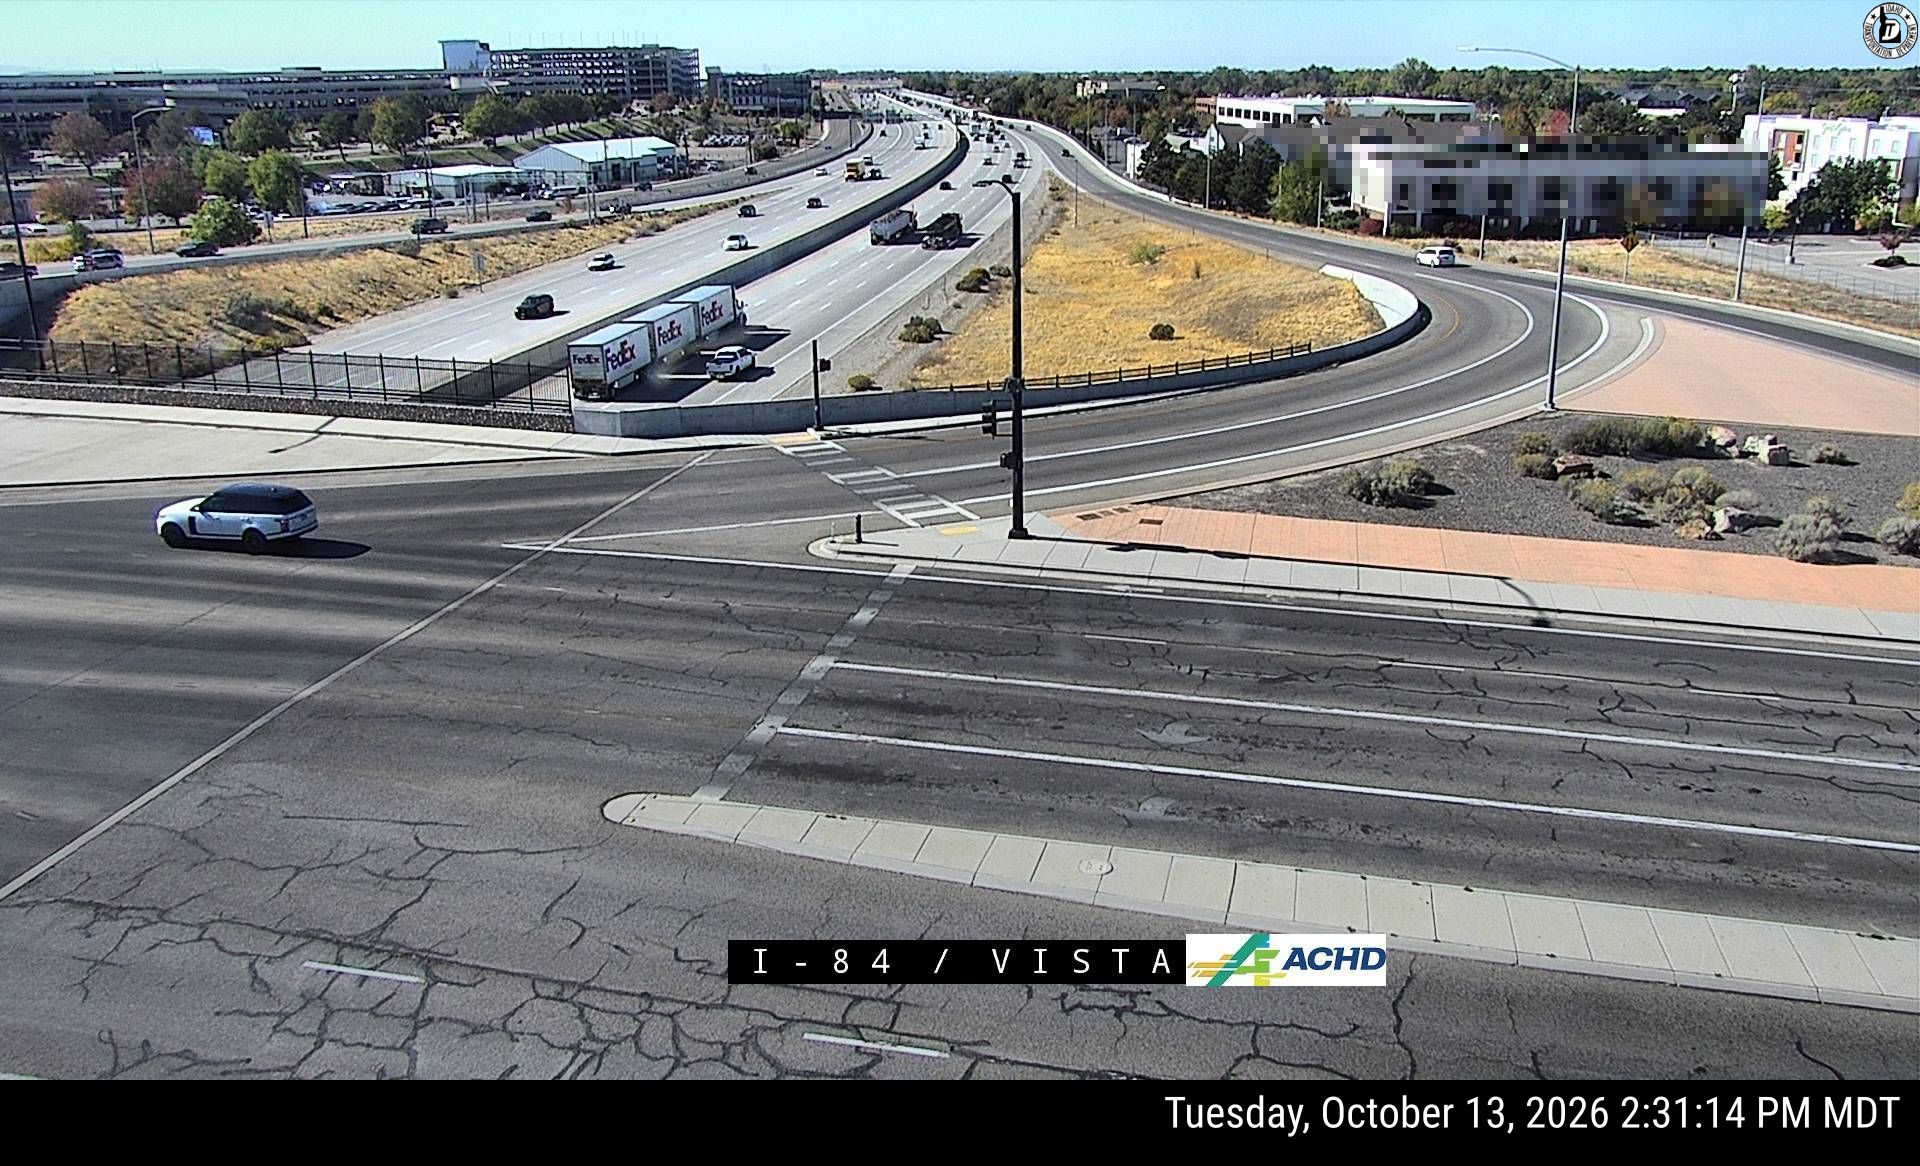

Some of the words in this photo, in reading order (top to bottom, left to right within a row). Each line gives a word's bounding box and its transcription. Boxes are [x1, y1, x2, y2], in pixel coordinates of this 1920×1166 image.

[700, 300, 723, 327] FedEx
[657, 320, 682, 346] FedEx
[572, 354, 601, 364] FedEx
[605, 339, 636, 373] FedEx
